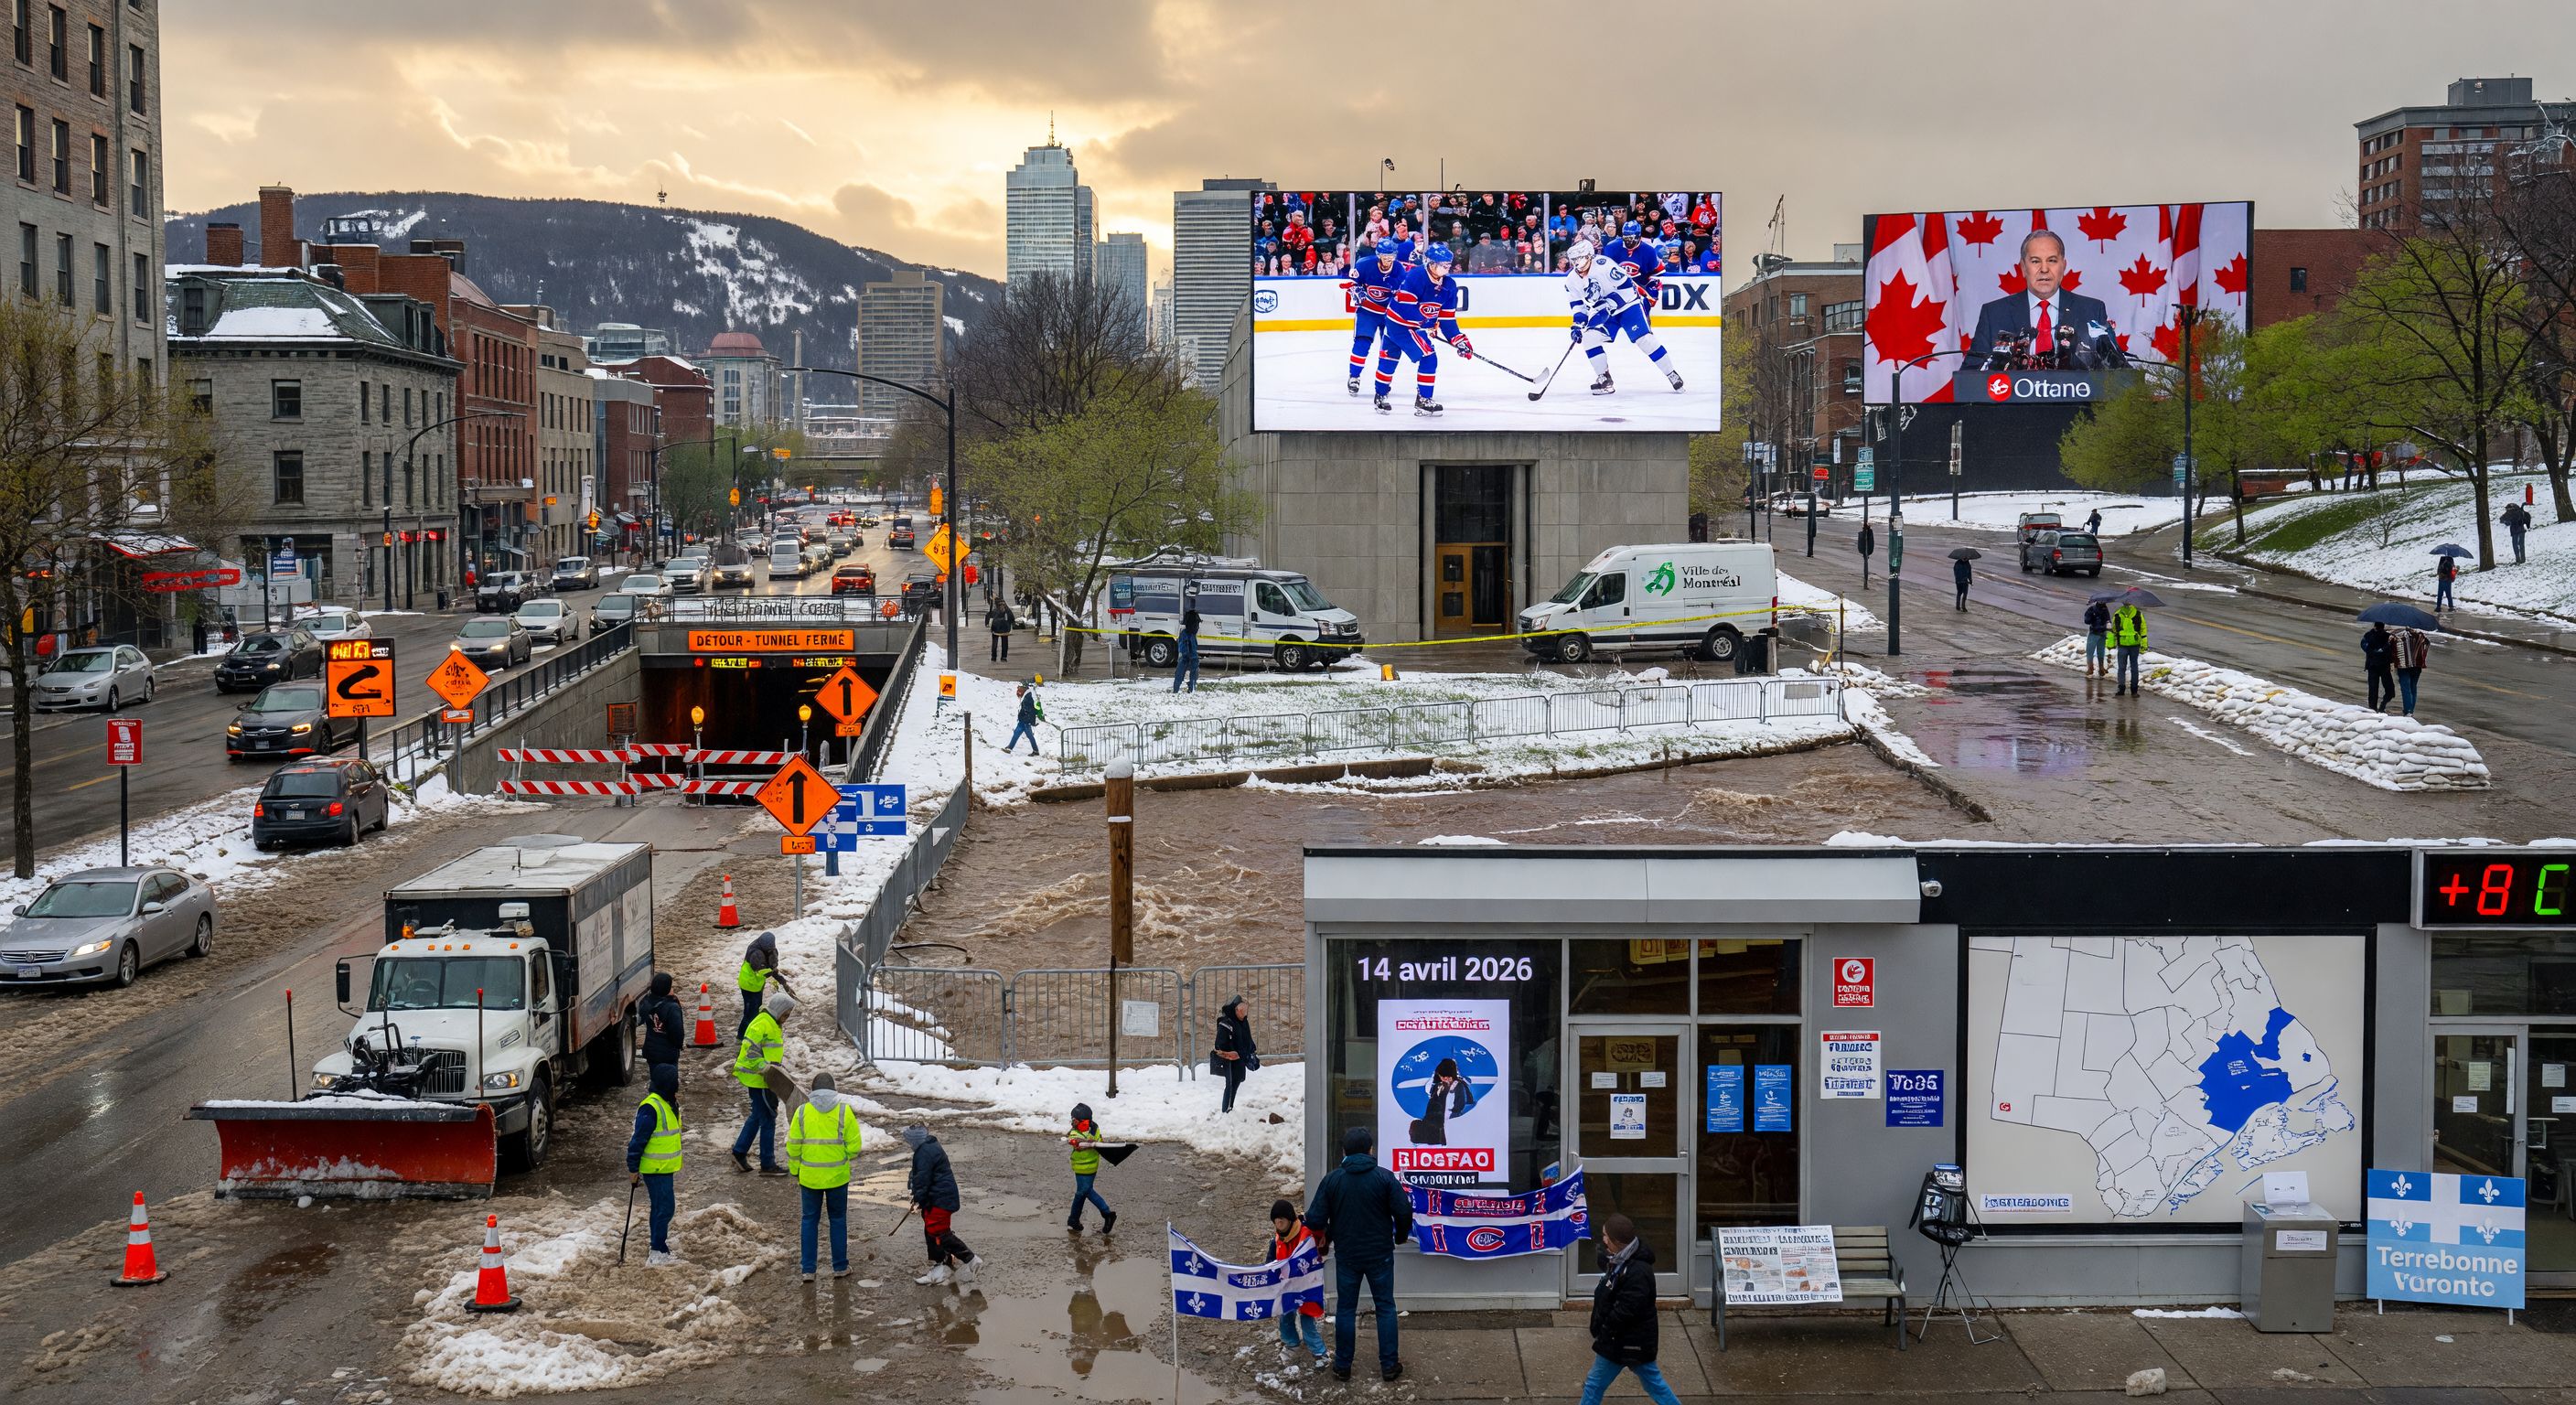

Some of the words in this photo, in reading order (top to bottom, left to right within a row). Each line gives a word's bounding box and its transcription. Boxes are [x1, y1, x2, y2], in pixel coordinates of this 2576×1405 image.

[756, 634, 800, 646] TUNNEL
[806, 631, 845, 646] FERMÉ
[2440, 864, 2514, 915] +8
[2535, 864, 2570, 915] C
[1358, 957, 1391, 981] 14
[1399, 956, 1457, 981] avril
[1465, 957, 1533, 981] 2026
[2376, 1246, 2518, 1275] Terrebonne
